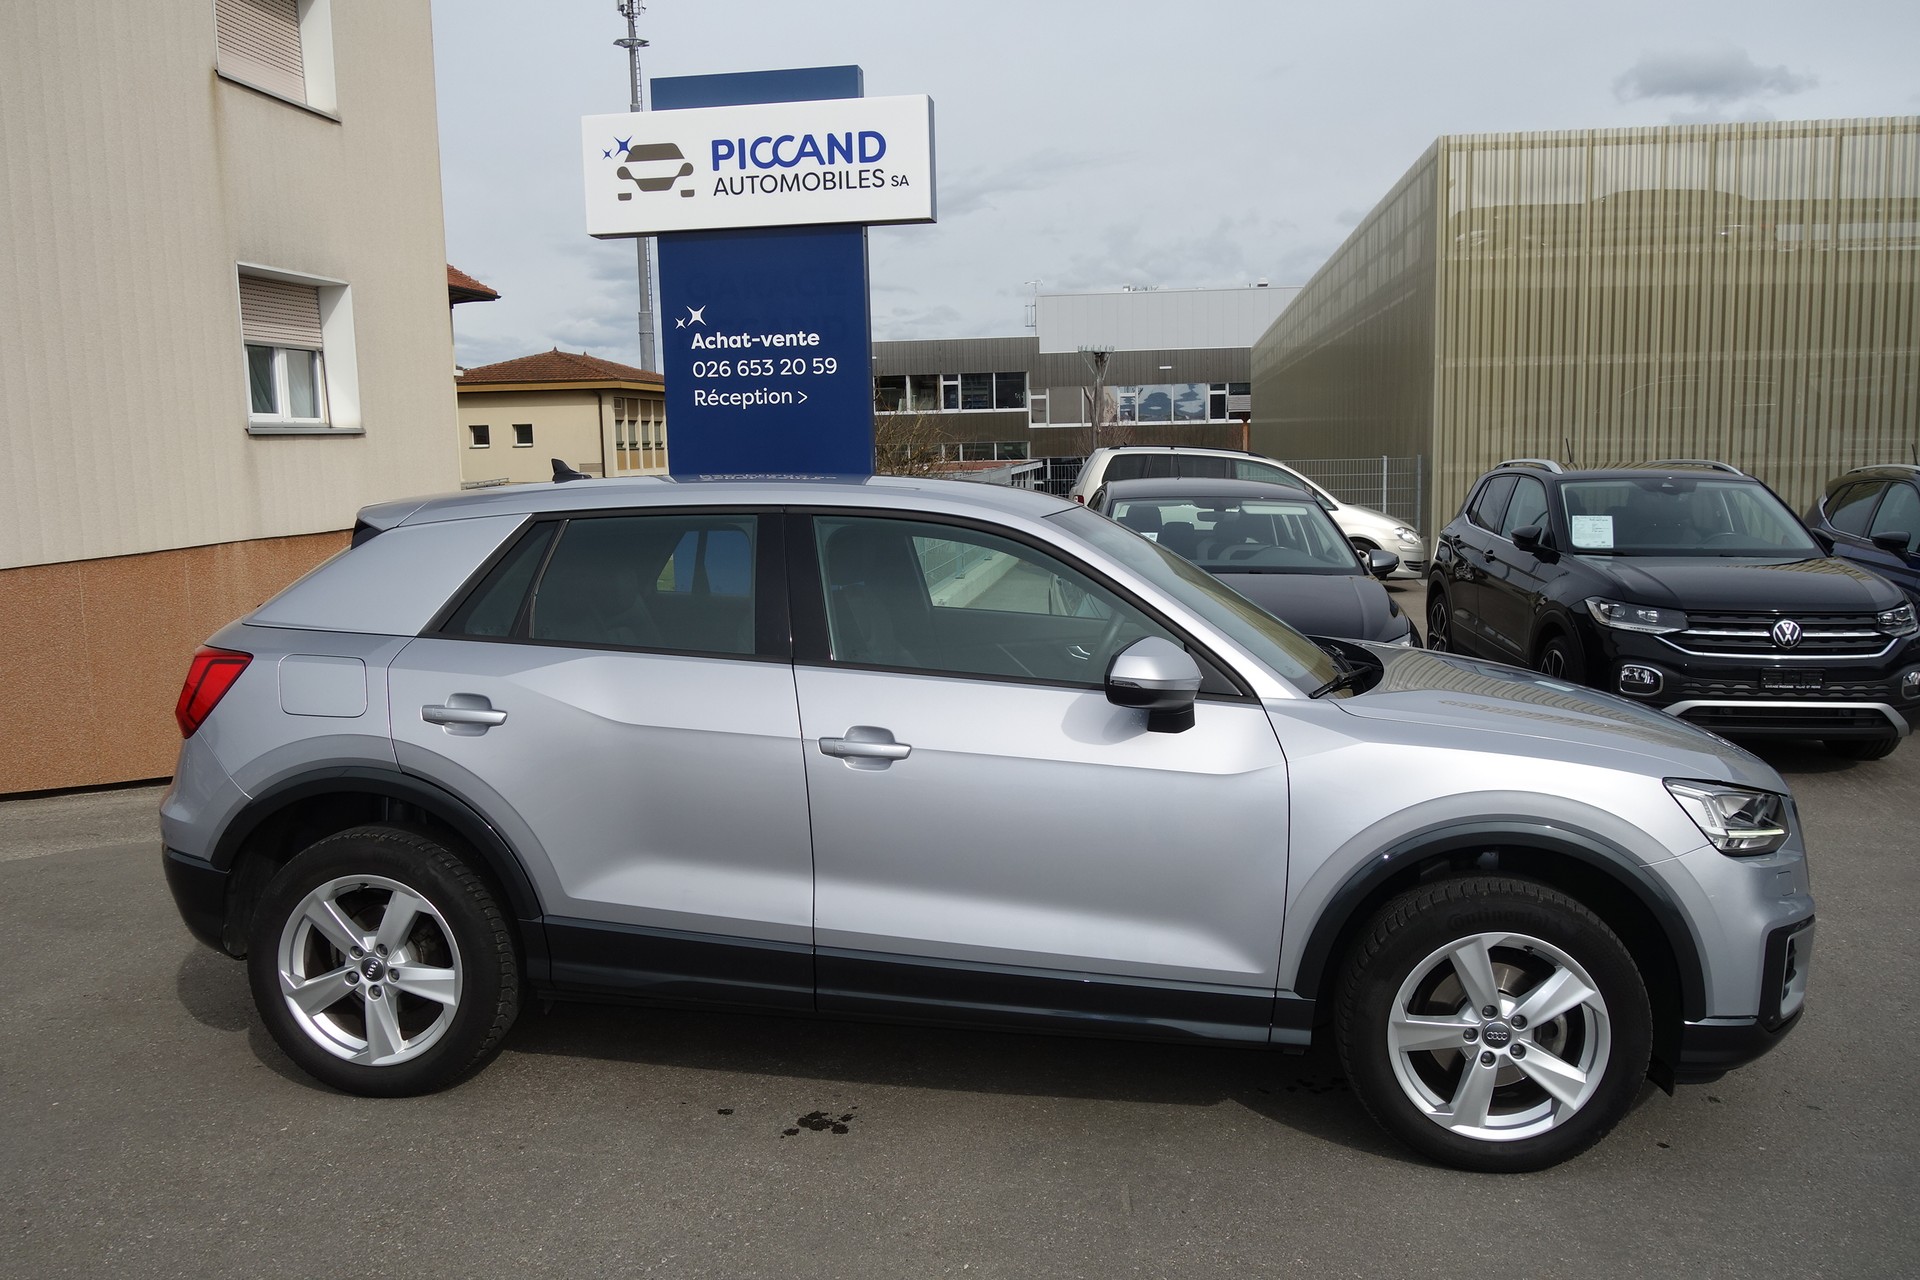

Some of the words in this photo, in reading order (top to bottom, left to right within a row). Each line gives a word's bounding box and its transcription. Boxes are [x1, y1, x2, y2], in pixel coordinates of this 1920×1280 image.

[711, 131, 886, 171] PICCAND
[713, 168, 885, 196] AUTOMOBILES
[891, 174, 909, 187] SA
[691, 331, 820, 350] Achat-vente
[692, 360, 731, 378] 026
[737, 359, 774, 377] 653
[780, 358, 806, 376] 20
[812, 357, 838, 375] 59
[694, 388, 793, 410] Réception
